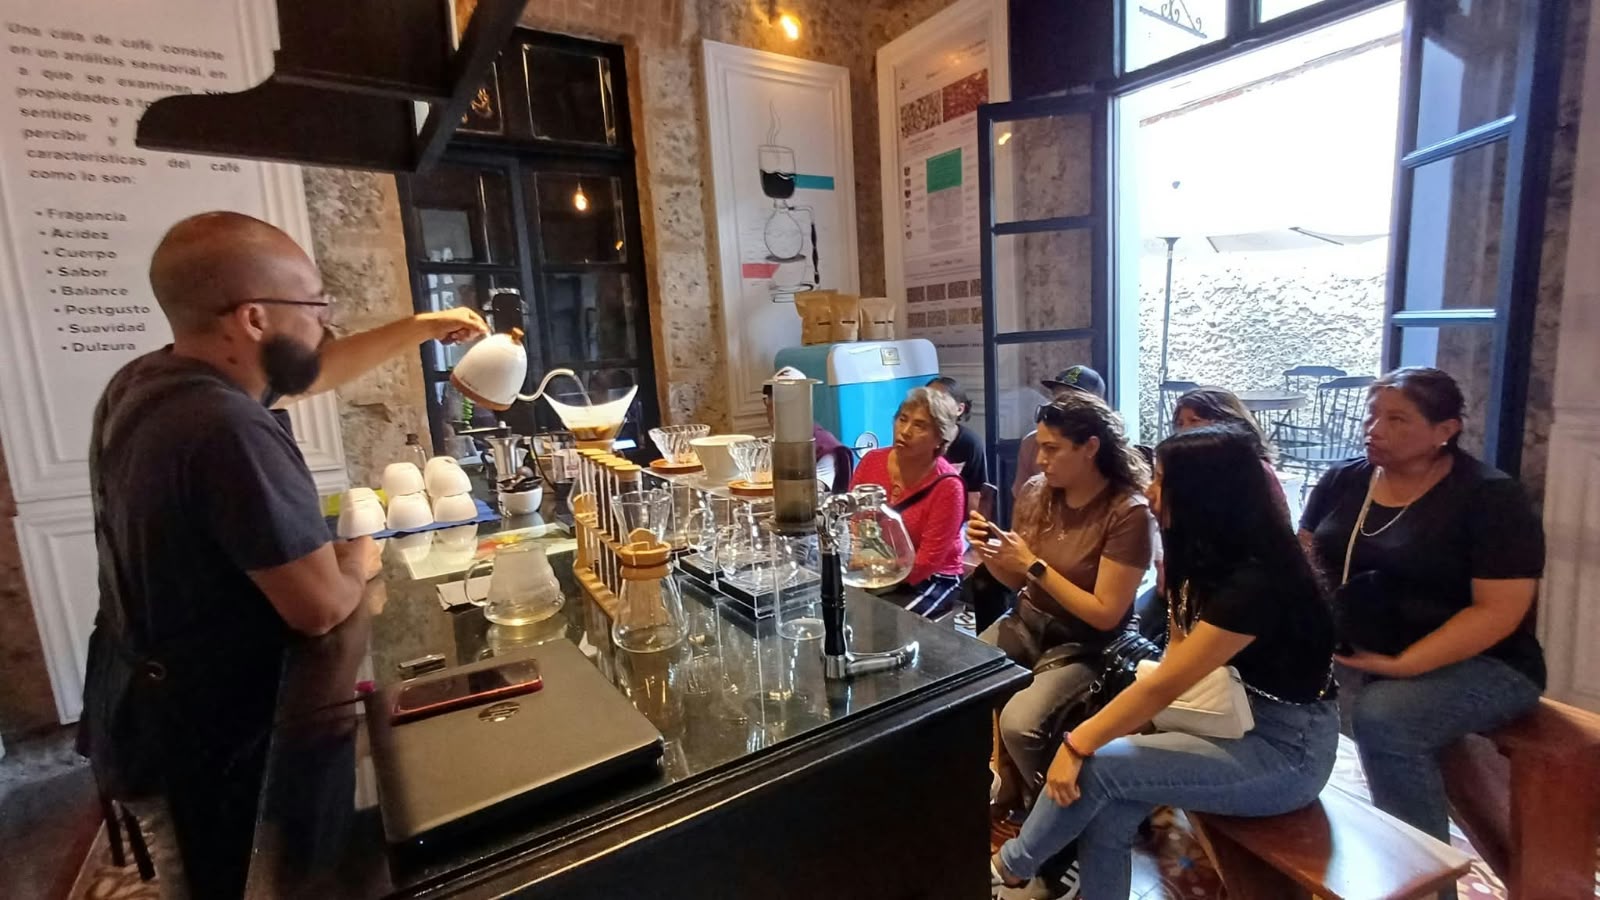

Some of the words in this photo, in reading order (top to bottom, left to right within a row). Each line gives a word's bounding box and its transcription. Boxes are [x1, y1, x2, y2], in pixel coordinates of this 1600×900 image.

[8, 23, 41, 36] Una
[50, 30, 84, 42] cata
[94, 34, 112, 45] de
[161, 45, 224, 61] consiste
[9, 45, 31, 56] en
[37, 48, 58, 59] un
[63, 51, 125, 67] análisis
[130, 59, 206, 78] sensorial,
[209, 68, 227, 79] en
[18, 66, 28, 76] a
[42, 69, 73, 82] que
[85, 74, 104, 85] se
[16, 87, 120, 106] propiedades
[20, 107, 93, 123] sentidos
[108, 115, 118, 128] y
[23, 128, 87, 143] percibir
[107, 134, 117, 147] y
[26, 148, 147, 167] características
[167, 157, 191, 170] del
[210, 161, 240, 174] café
[29, 169, 77, 182] como
[82, 171, 97, 182] lo
[102, 174, 137, 185] son:
[46, 207, 127, 223] Fragancia
[51, 227, 109, 240] Acidez
[54, 246, 118, 261] Cuerpo
[57, 265, 108, 277] Sabor
[61, 284, 129, 297] Balance
[64, 304, 151, 317] Postgusto
[68, 322, 146, 334] Suavidad
[71, 341, 137, 353] Dulzura
